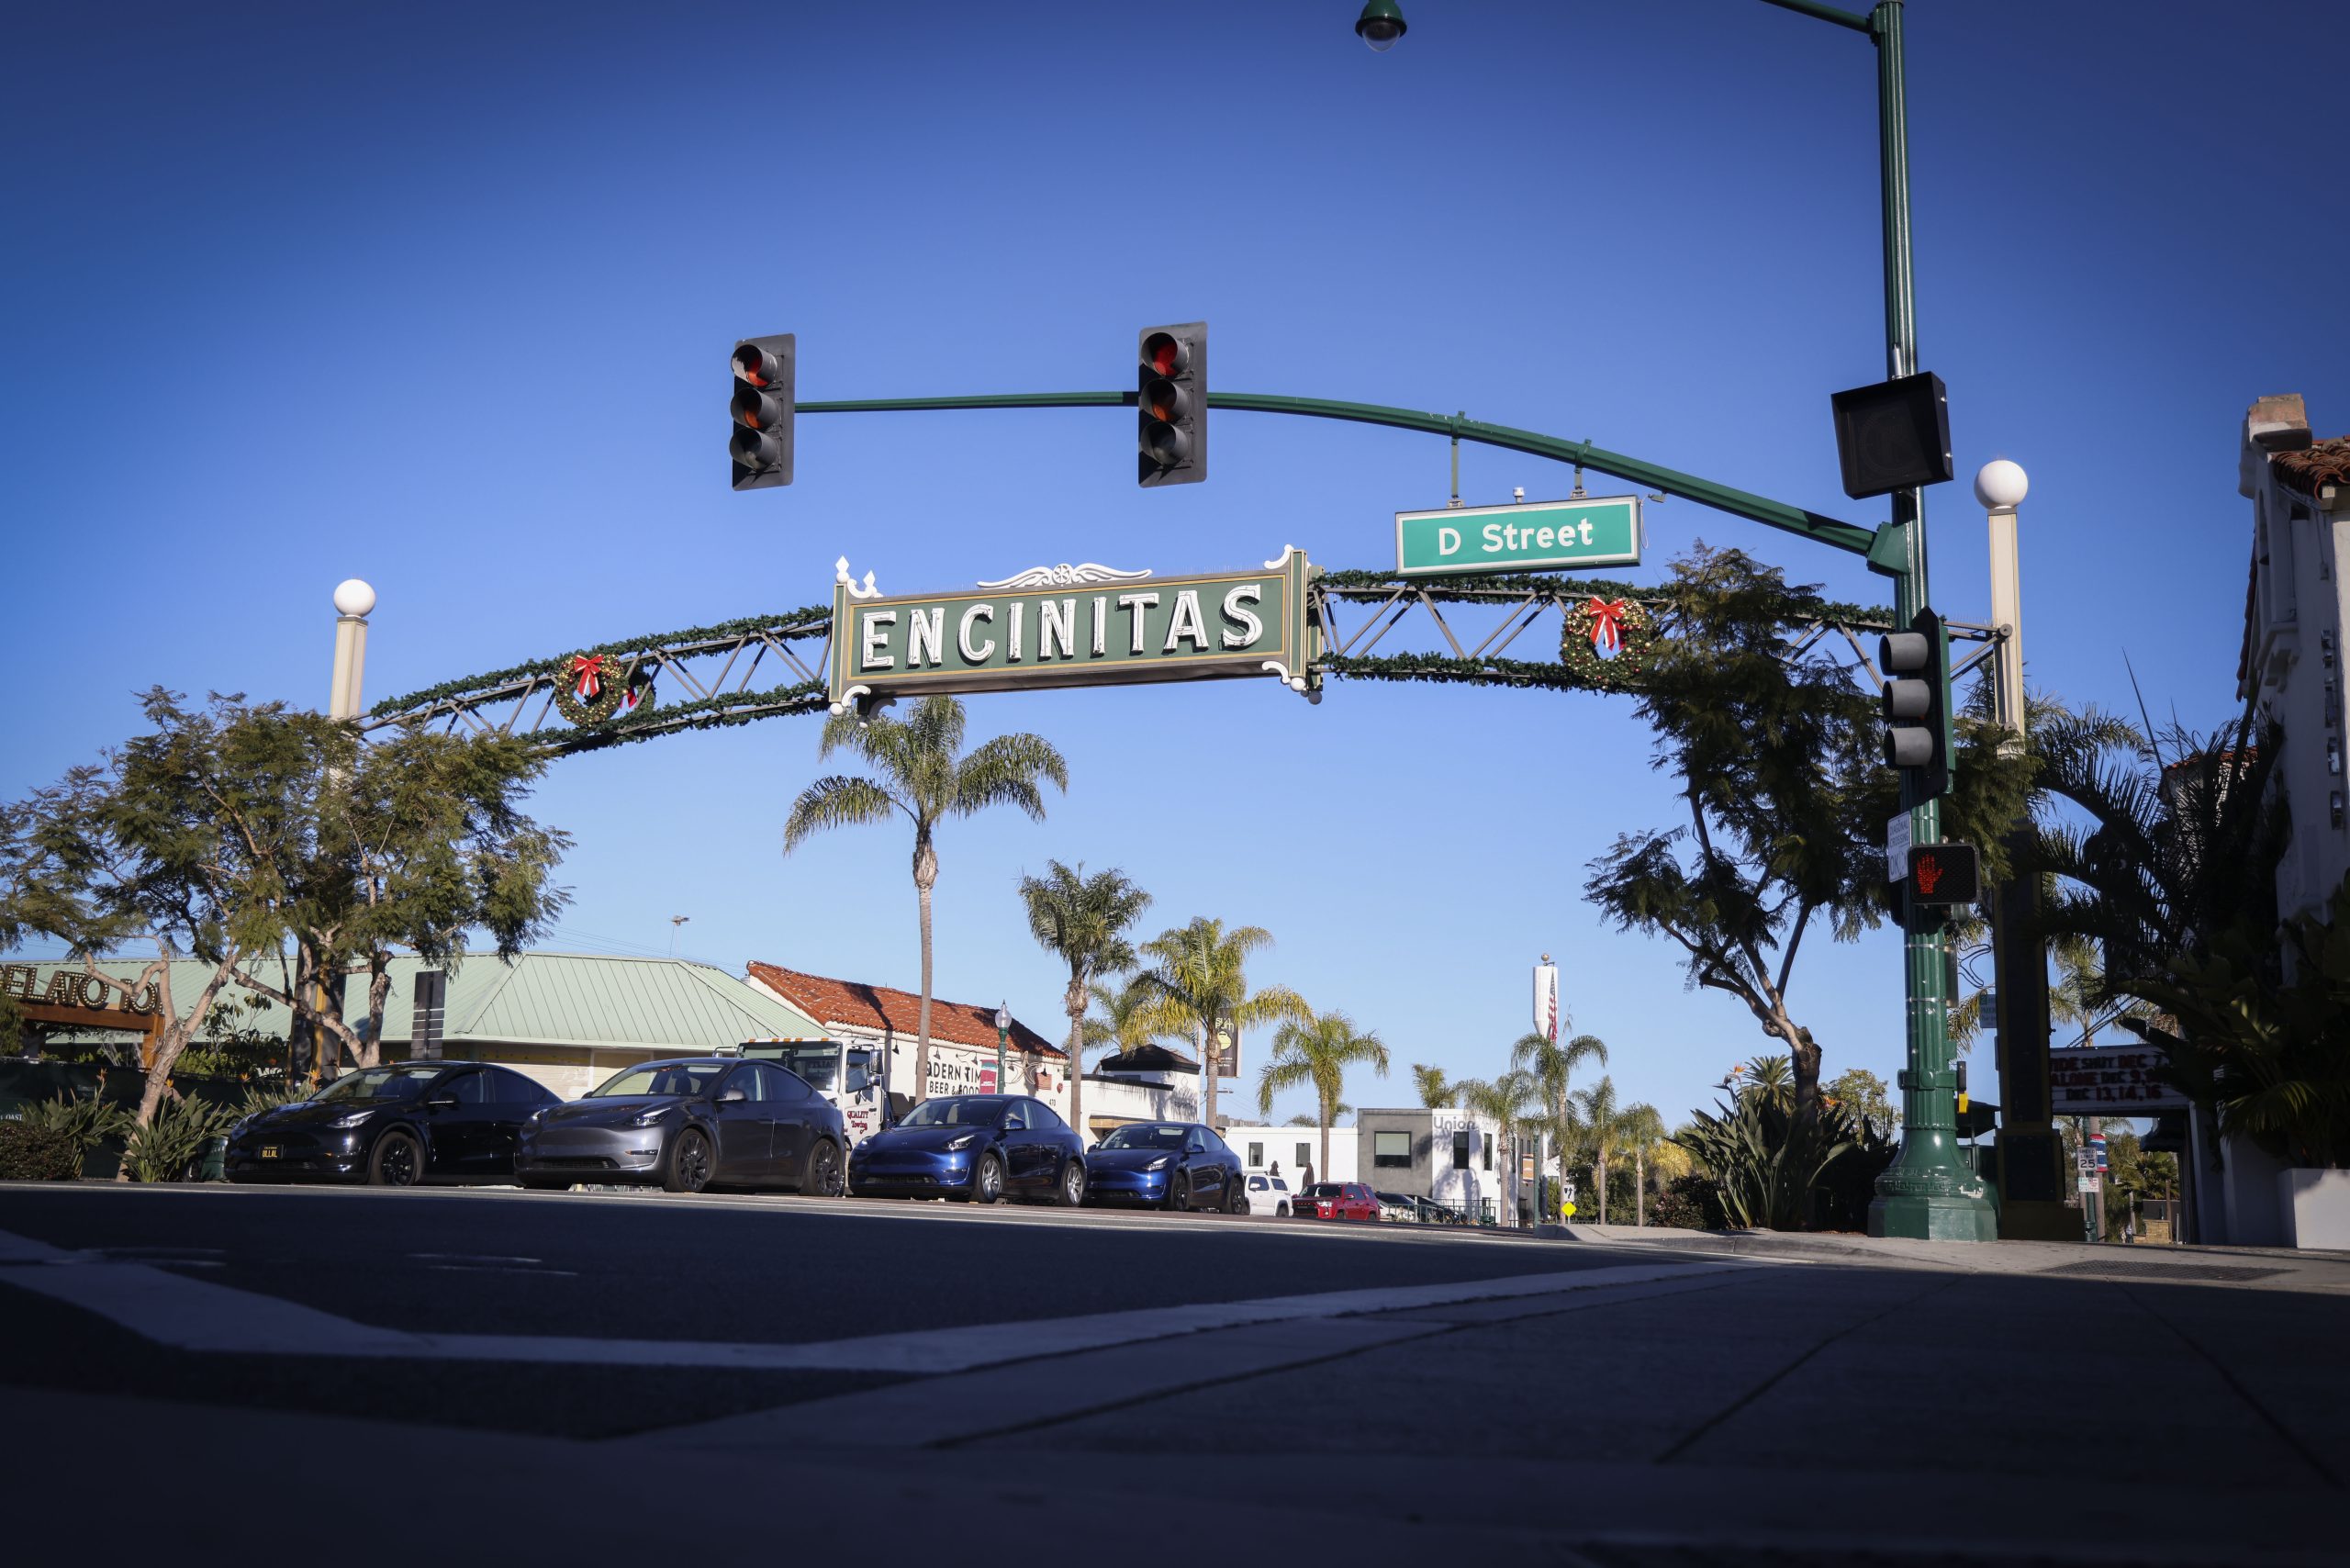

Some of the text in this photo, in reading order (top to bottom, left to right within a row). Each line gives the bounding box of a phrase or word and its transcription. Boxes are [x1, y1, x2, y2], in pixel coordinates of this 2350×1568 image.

[1438, 518, 1593, 555] D Street
[860, 584, 1263, 669] ENCINITAS
[1889, 831, 1908, 847] CROSSING
[0, 965, 109, 1011] ELATO
[2118, 1054, 2146, 1069] DEC
[916, 1060, 981, 1083] ODERN TIM
[929, 1081, 949, 1095] BEER
[951, 1085, 956, 1095] &
[847, 1110, 868, 1120] QUALITY
[851, 1120, 867, 1135] Towing
[1433, 1116, 1476, 1130] Union
[2080, 1159, 2096, 1168] 25
